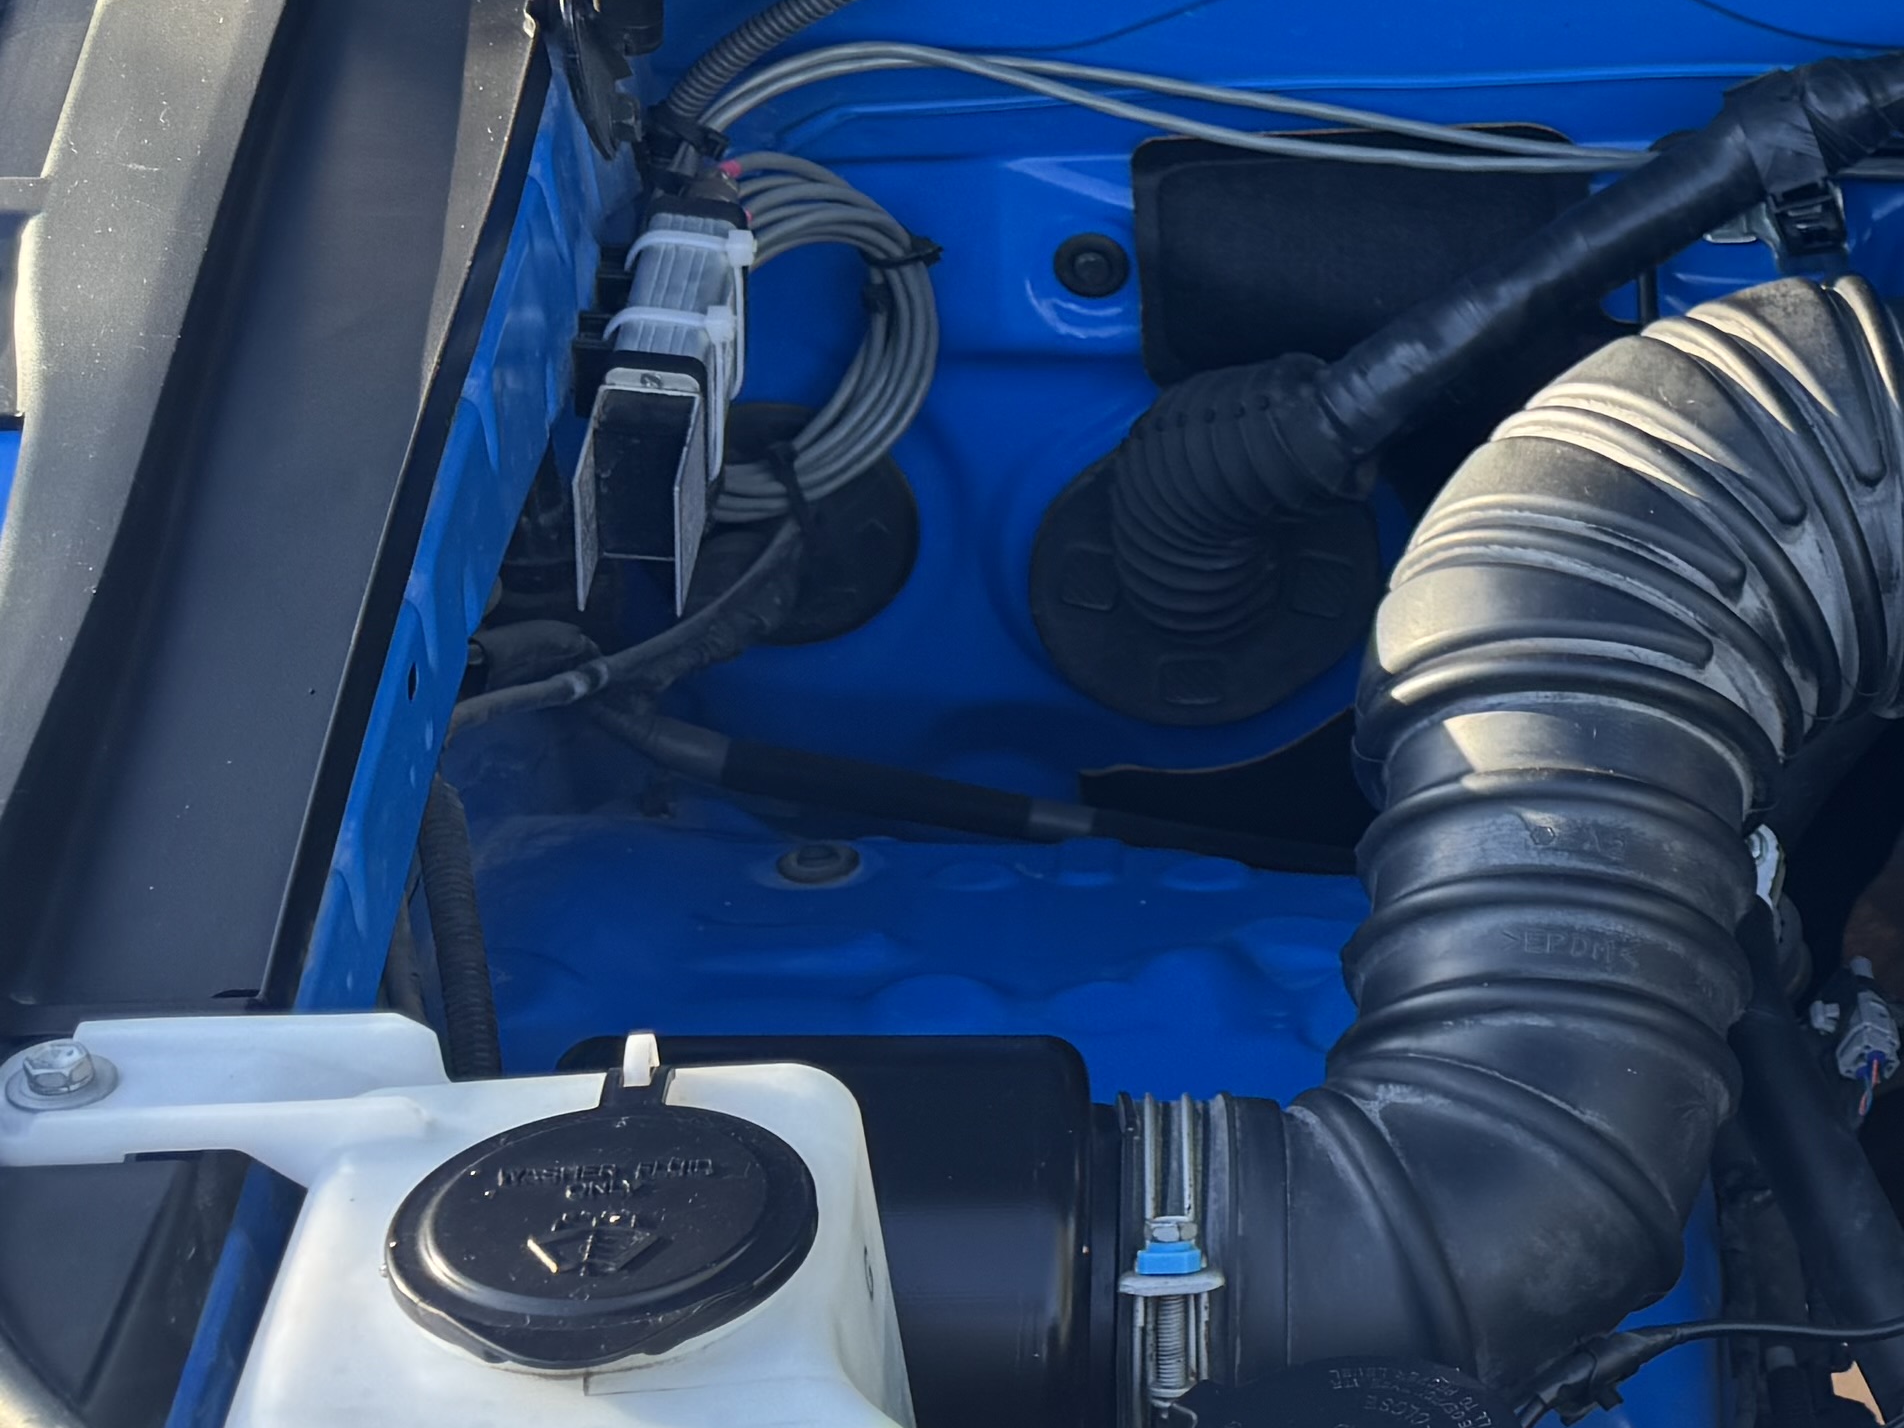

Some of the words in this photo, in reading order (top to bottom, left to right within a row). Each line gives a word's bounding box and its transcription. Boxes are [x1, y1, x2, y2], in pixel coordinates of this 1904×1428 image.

[498, 1163, 619, 1187] WASHER
[634, 1157, 715, 1180] FLUID
[564, 1178, 640, 1201] ONLY
[1364, 1393, 1432, 1426] CLOSE
